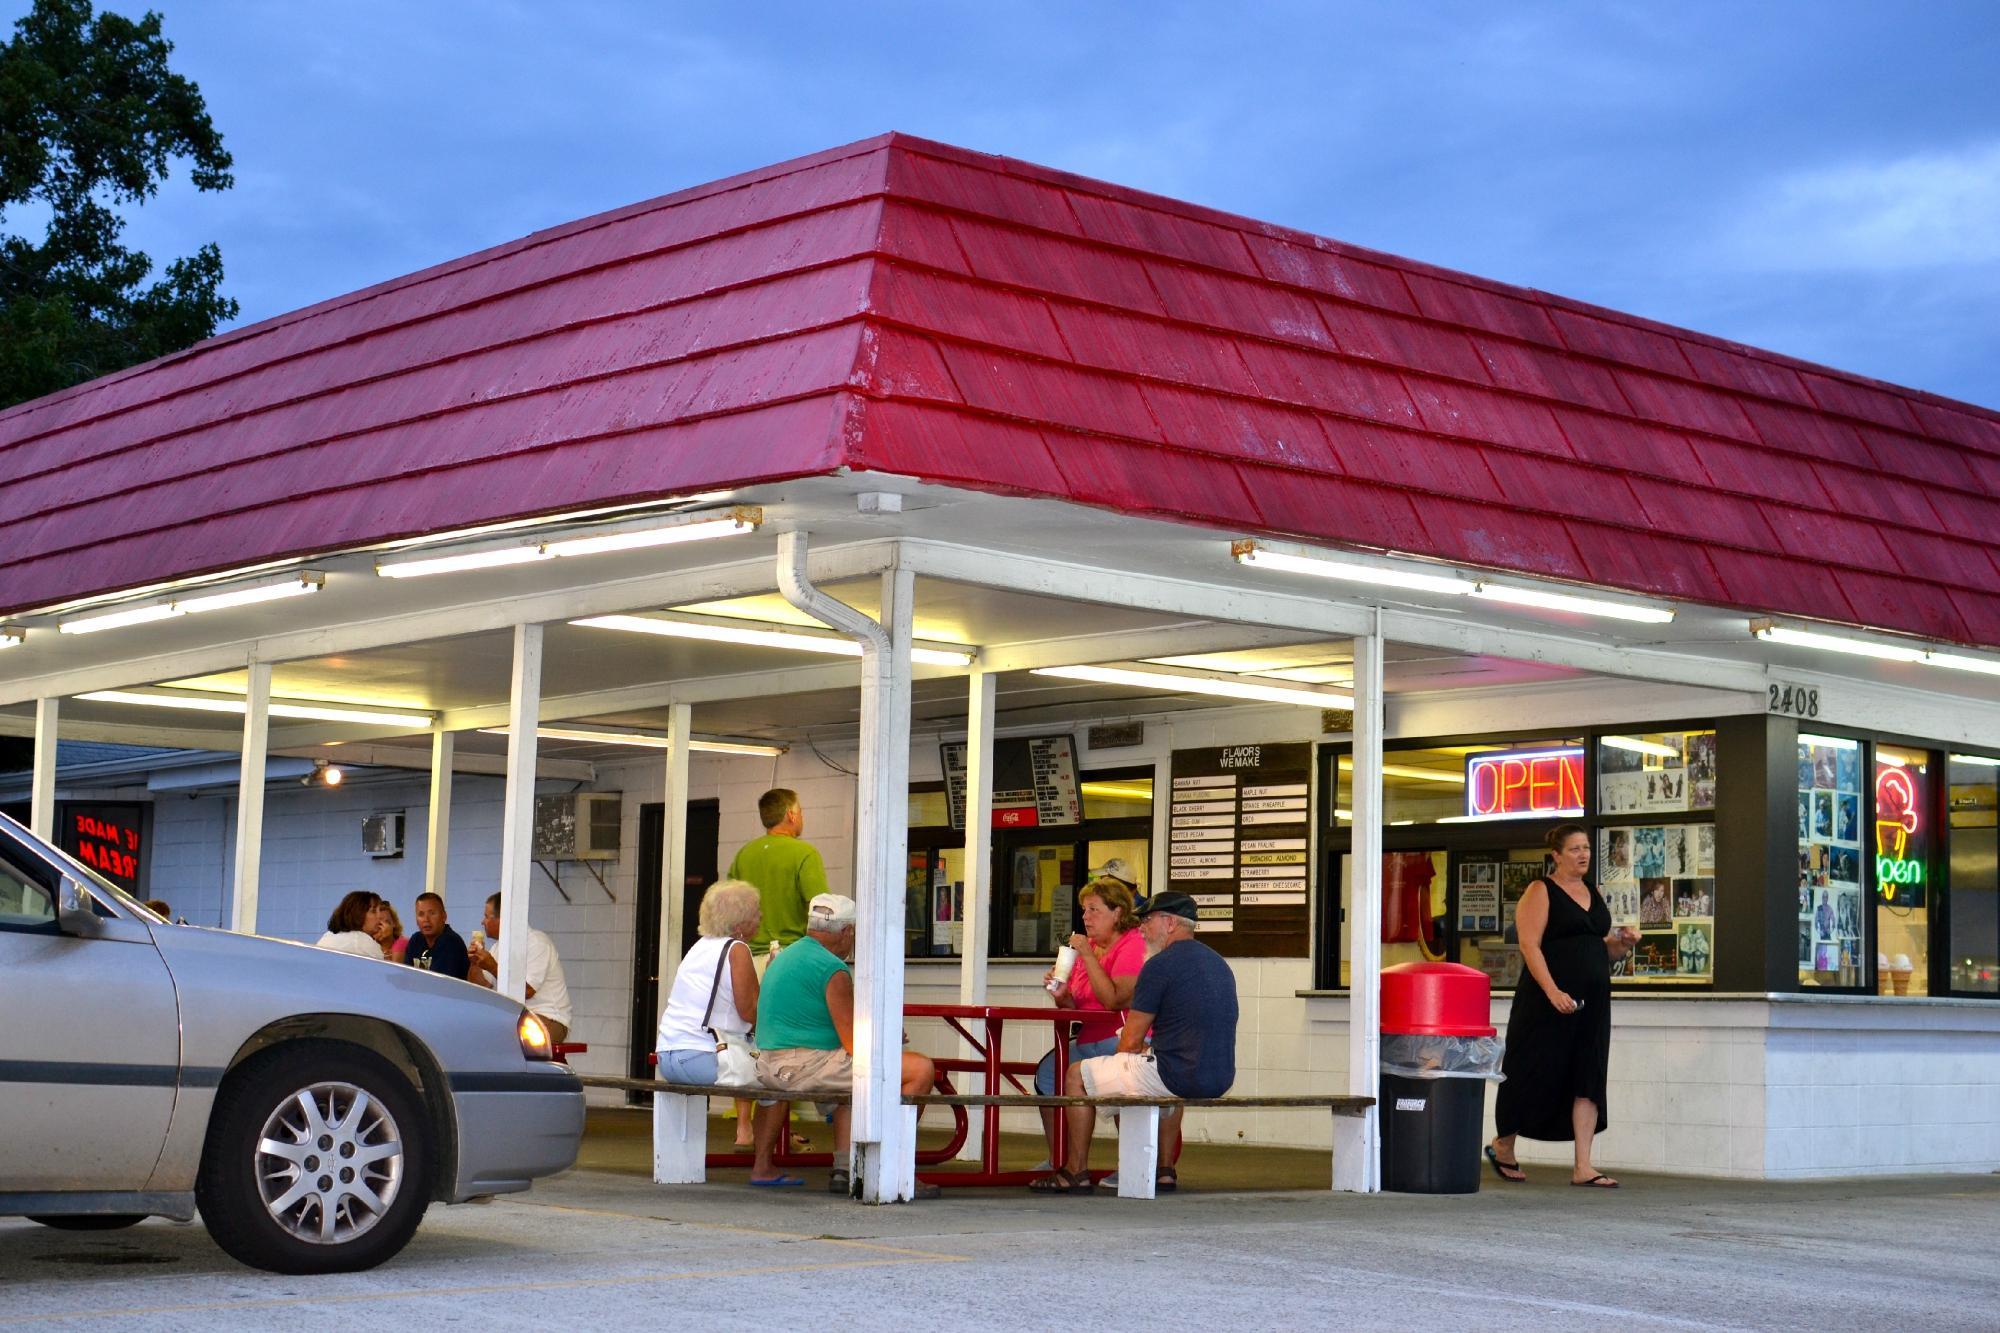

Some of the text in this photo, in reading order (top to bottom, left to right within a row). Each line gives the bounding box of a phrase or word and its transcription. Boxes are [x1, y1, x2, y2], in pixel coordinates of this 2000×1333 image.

[1768, 683, 1819, 717] 2408
[1223, 746, 1261, 759] FLAVORS
[1472, 756, 1585, 814] OPEN
[1262, 800, 1286, 809] PINEAPPLE
[1172, 830, 1205, 839] BUTTER PECAN
[1172, 856, 1217, 865] CHOCOLATE ALMOND
[1275, 854, 1297, 862] ALMOND
[1241, 868, 1270, 876] STRAWBERRY
[1876, 853, 1921, 891] pen
[1272, 881, 1302, 889] CHEESECAKE
[1241, 895, 1259, 903] VANILLA
